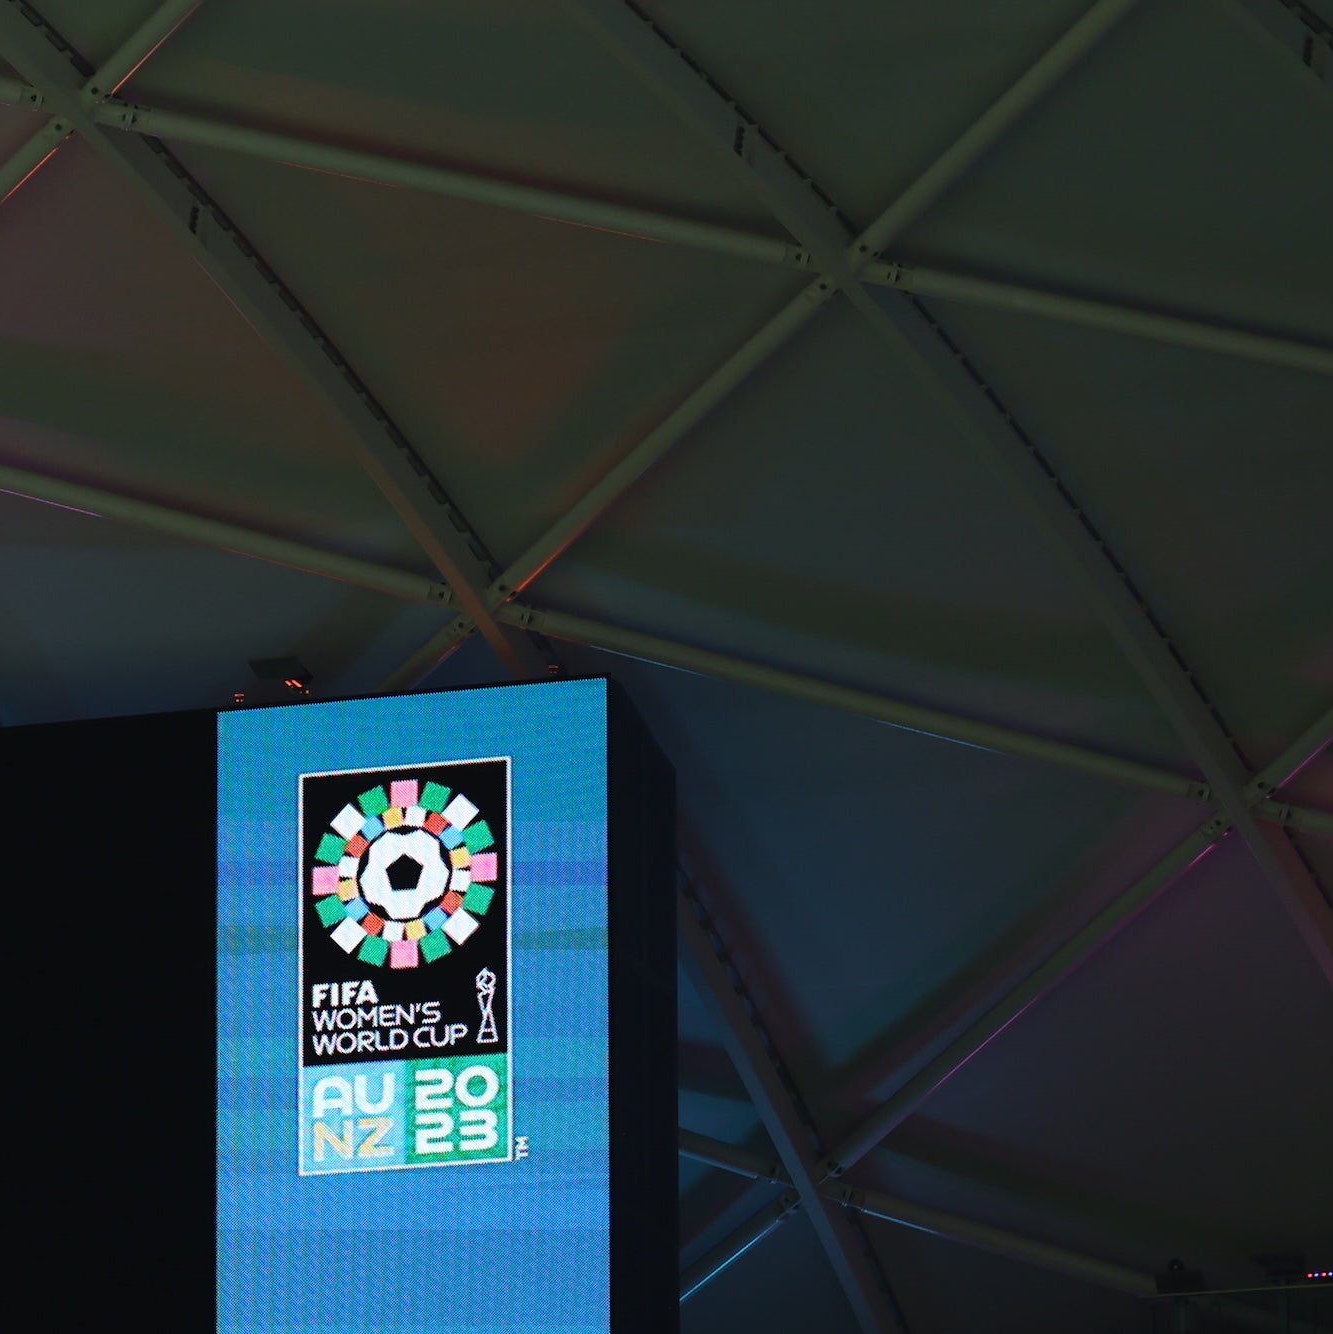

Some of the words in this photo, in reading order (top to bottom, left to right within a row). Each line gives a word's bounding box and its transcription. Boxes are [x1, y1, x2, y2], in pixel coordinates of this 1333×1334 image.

[311, 980, 379, 1009] FIFA
[311, 1001, 442, 1032] WOMEN'S
[311, 1026, 409, 1056] WORLD
[413, 1023, 468, 1050] CUP
[312, 1071, 395, 1118] AU
[313, 1116, 395, 1162] NZ
